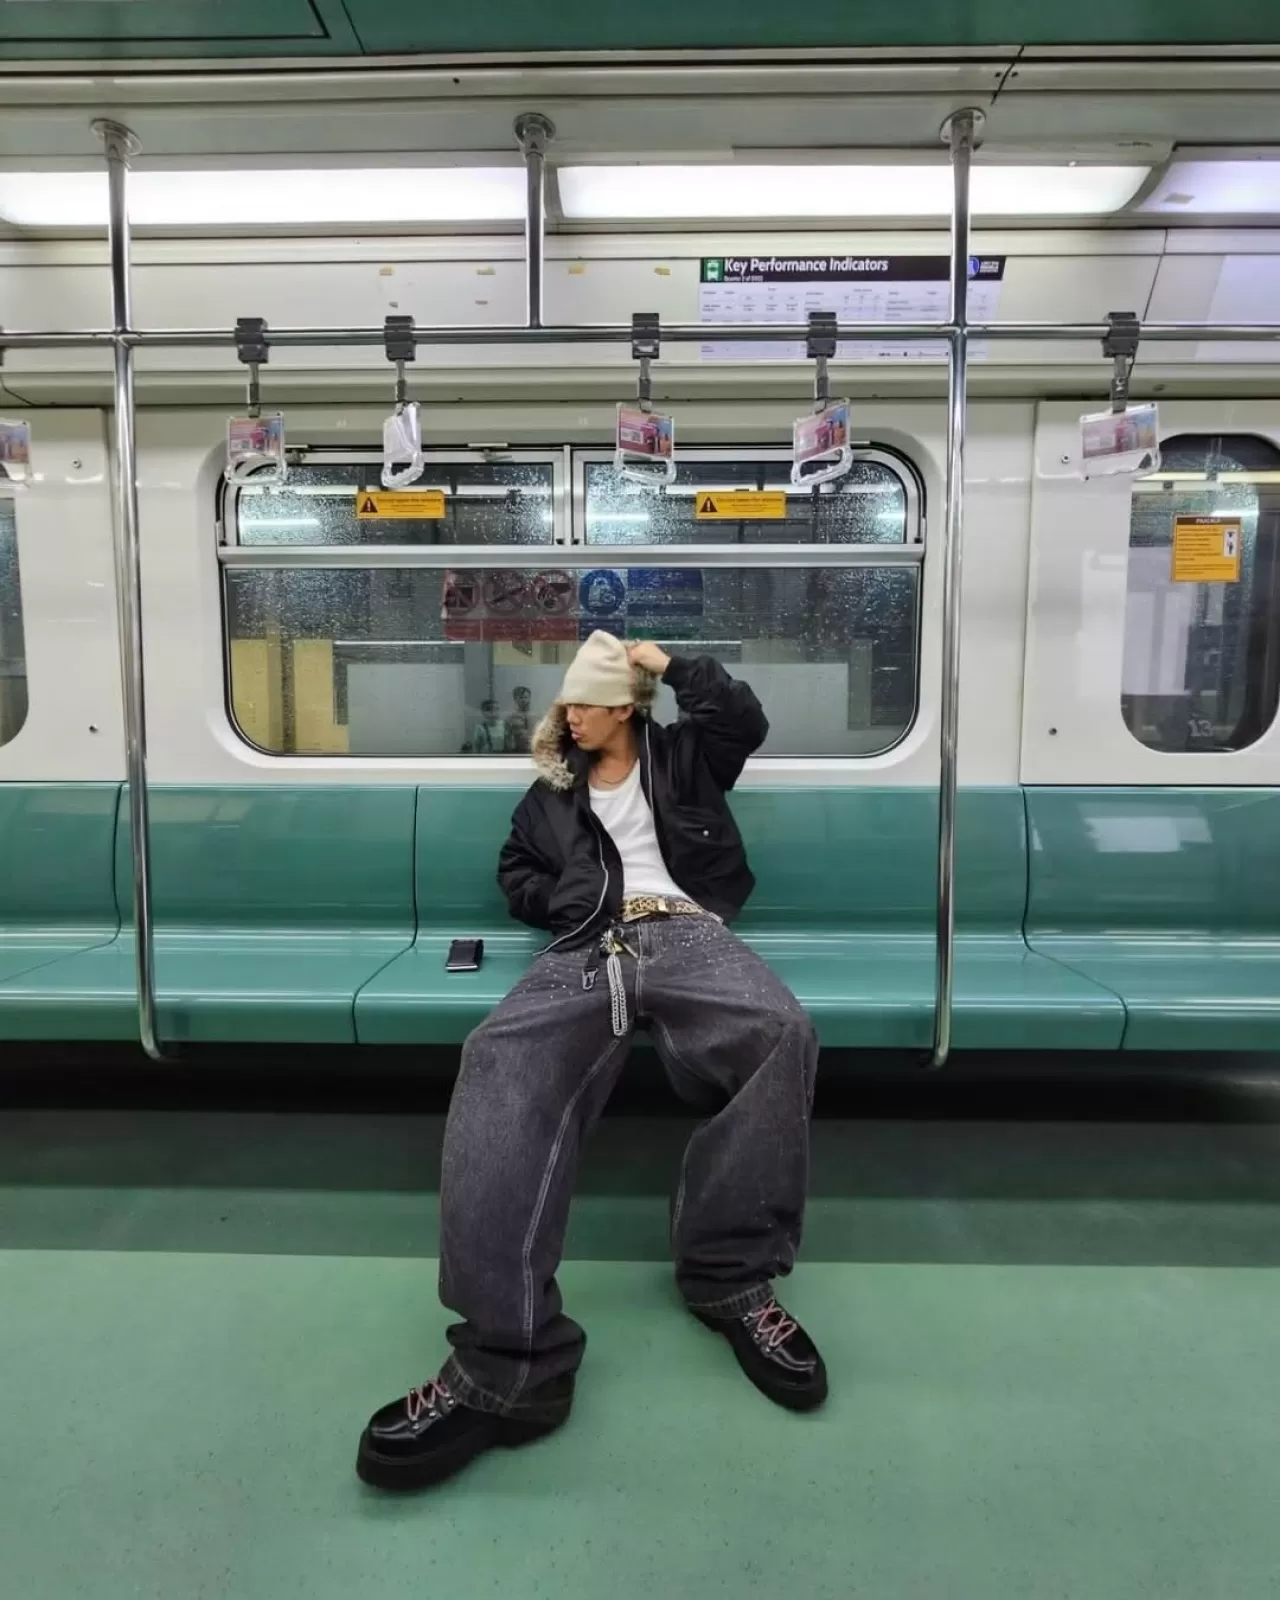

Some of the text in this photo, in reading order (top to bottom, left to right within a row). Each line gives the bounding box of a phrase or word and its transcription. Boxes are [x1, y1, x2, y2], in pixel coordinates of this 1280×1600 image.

[724, 256, 889, 276] Key Performance Indicators
[1188, 719, 1212, 737] 13
